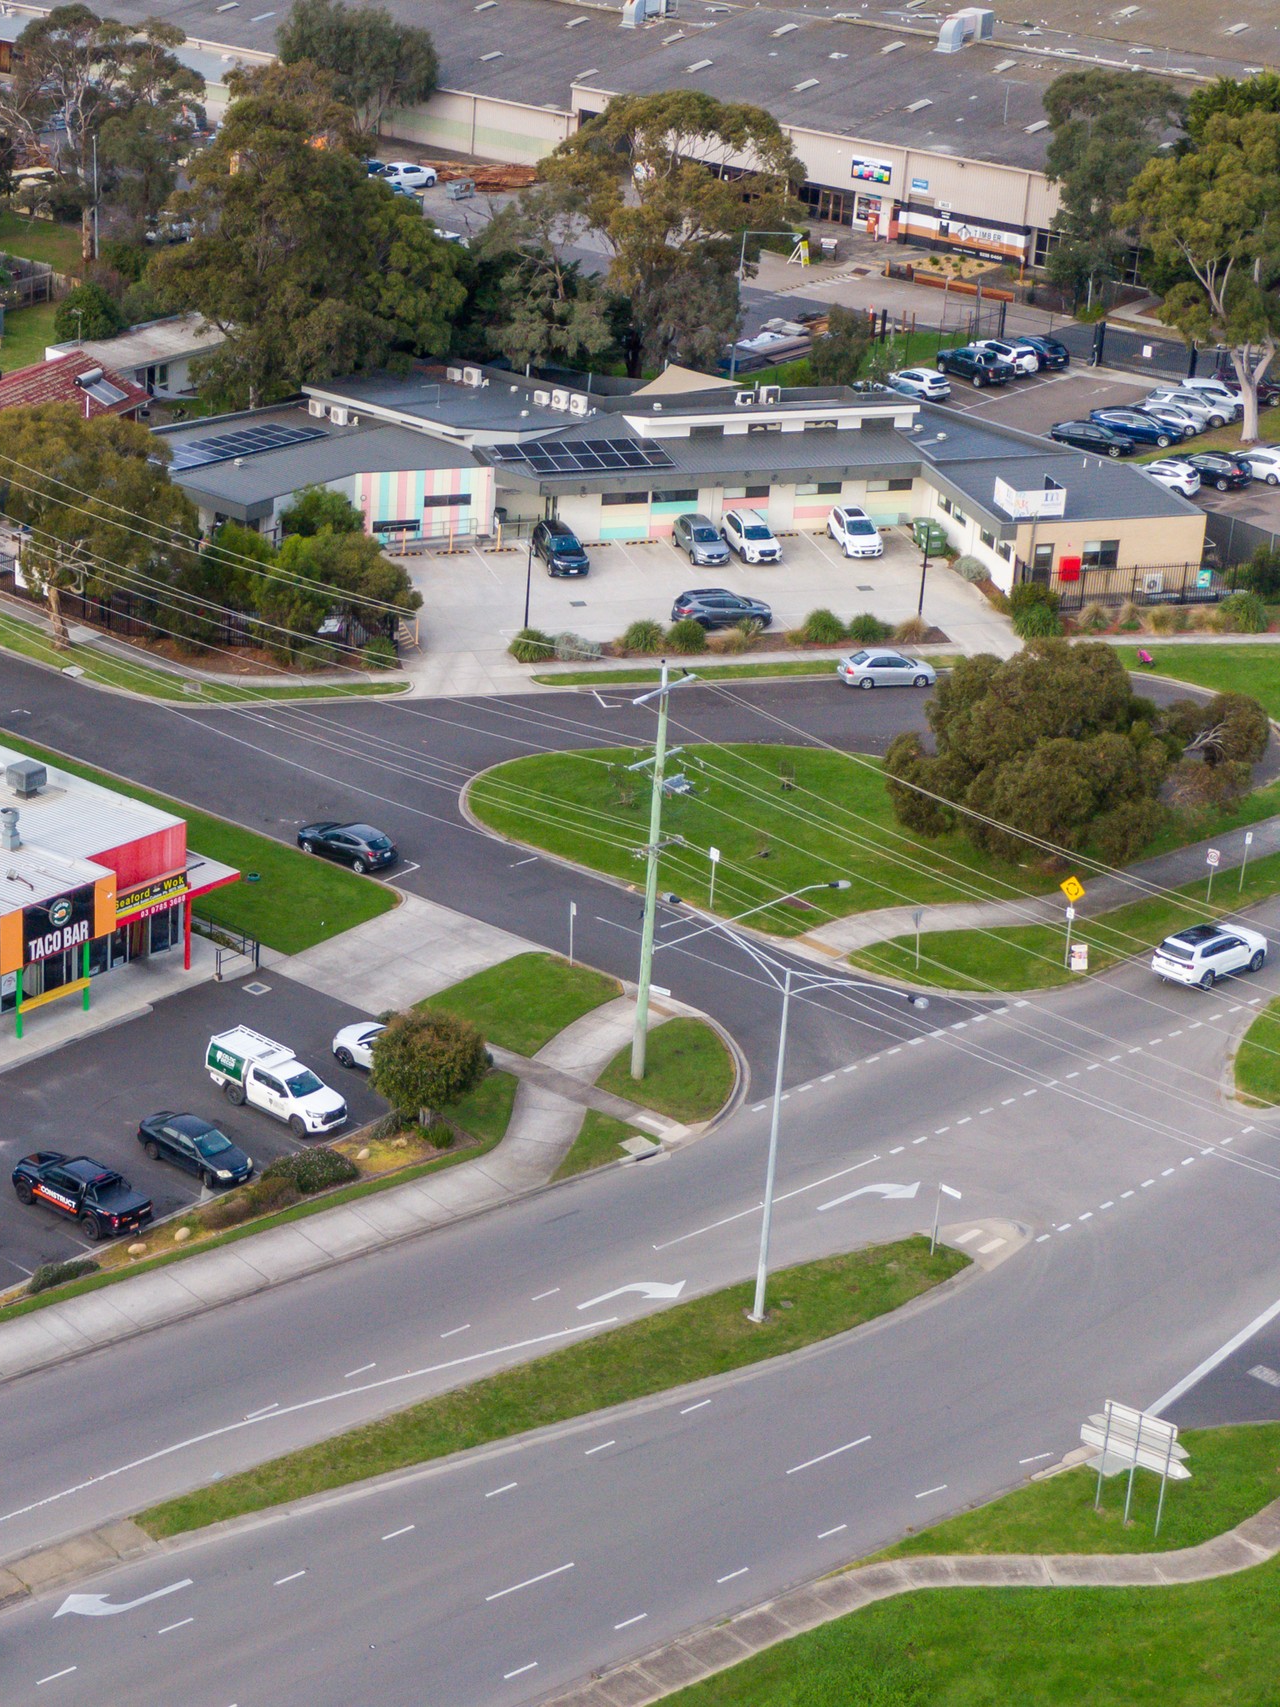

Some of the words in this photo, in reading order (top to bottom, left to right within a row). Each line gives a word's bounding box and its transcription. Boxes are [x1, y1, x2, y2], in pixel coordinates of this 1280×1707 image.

[973, 230, 1002, 240] TIMBER
[115, 888, 151, 909] Seaford
[163, 875, 185, 891] Wok
[28, 930, 62, 961] TACO
[63, 920, 89, 949] BAR
